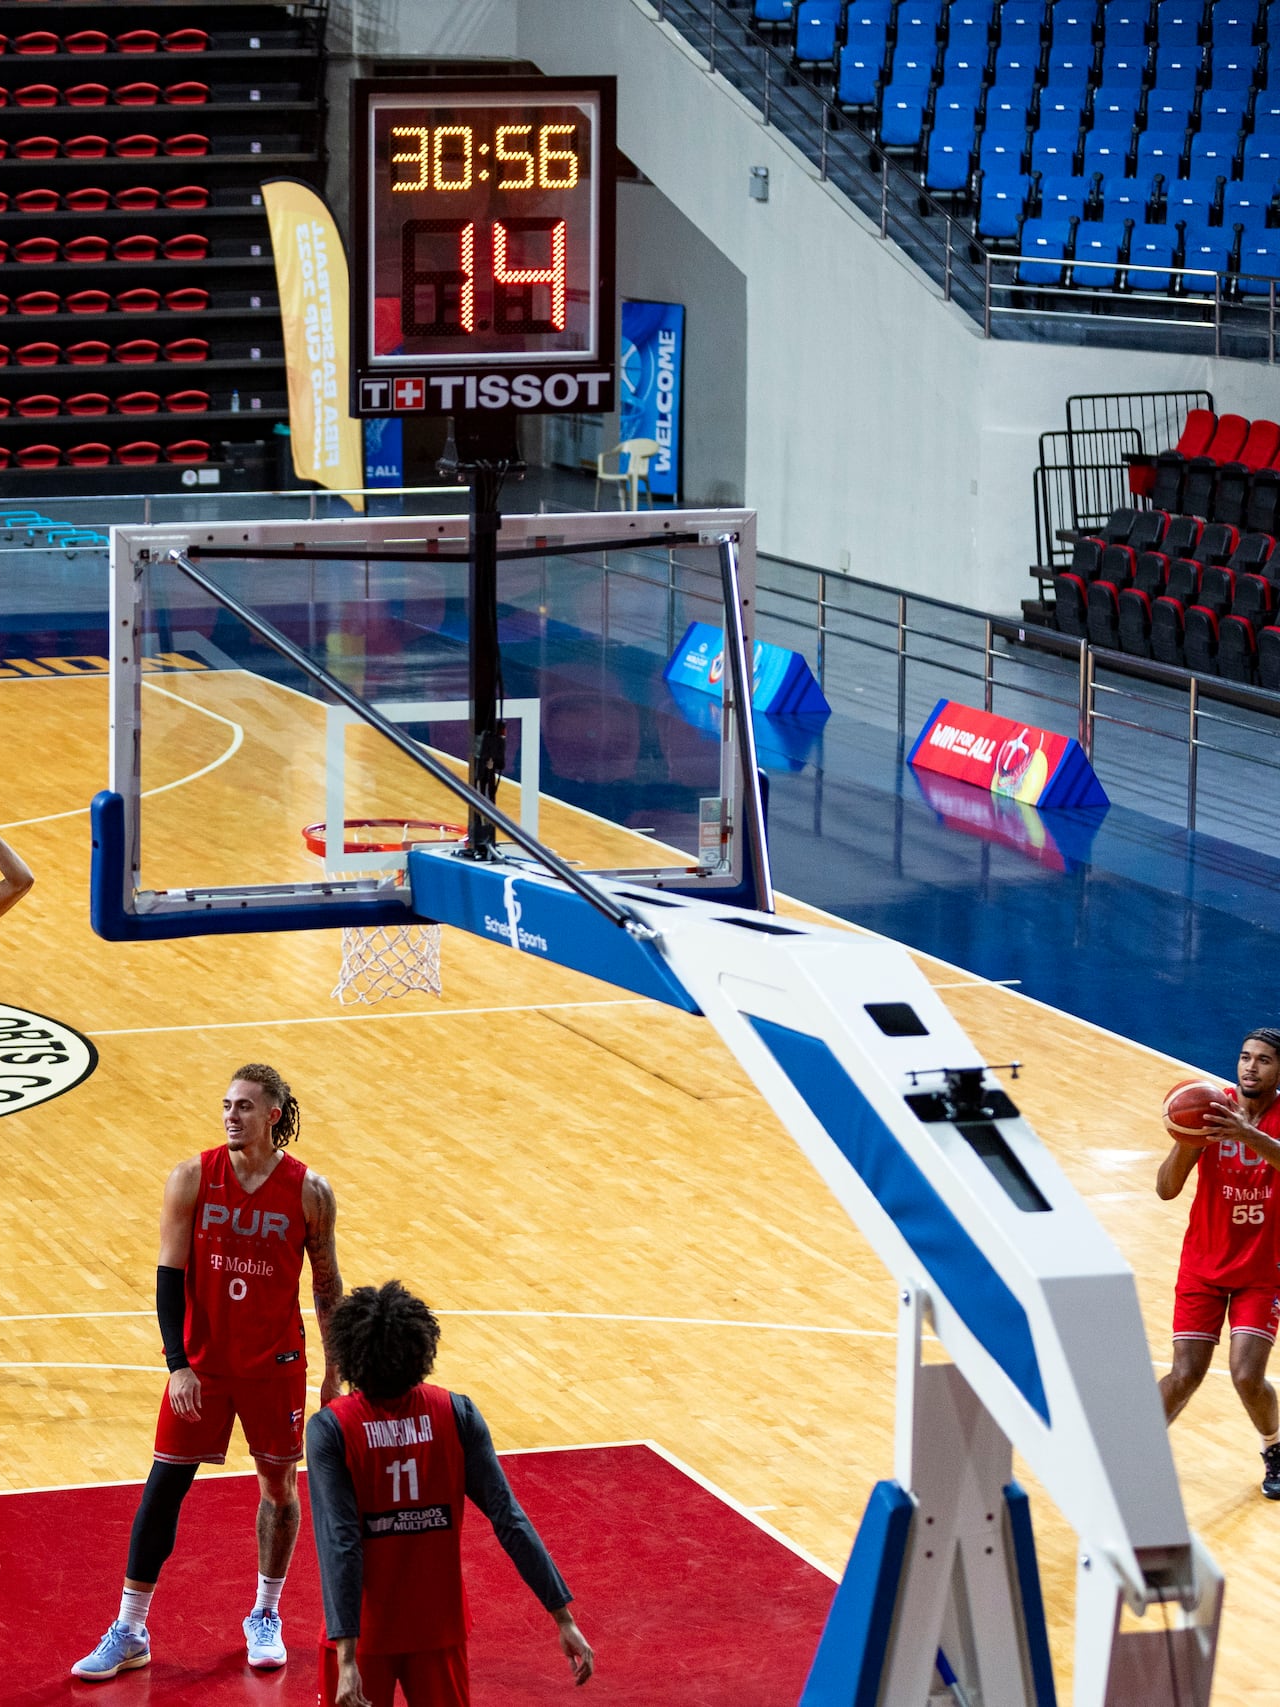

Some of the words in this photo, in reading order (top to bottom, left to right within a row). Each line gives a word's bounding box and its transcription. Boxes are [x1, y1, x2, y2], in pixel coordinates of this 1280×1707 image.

[392, 124, 578, 192] 30:56
[460, 220, 567, 333] 14
[429, 372, 611, 410] TISSOT
[654, 330, 676, 472] WELCOME
[929, 722, 959, 752] WIN
[956, 731, 976, 749] FOR
[967, 735, 997, 764] ALL
[518, 927, 548, 952] Sports
[1218, 1139, 1269, 1166] PU
[201, 1203, 290, 1242] PUR
[1231, 1204, 1265, 1225] 55
[224, 1256, 274, 1277] Mobile
[228, 1277, 248, 1301] 0
[362, 1417, 418, 1449] THOMPSON
[417, 1414, 433, 1443] JR
[385, 1457, 420, 1503] 11
[397, 1507, 443, 1522] SEGUROS
